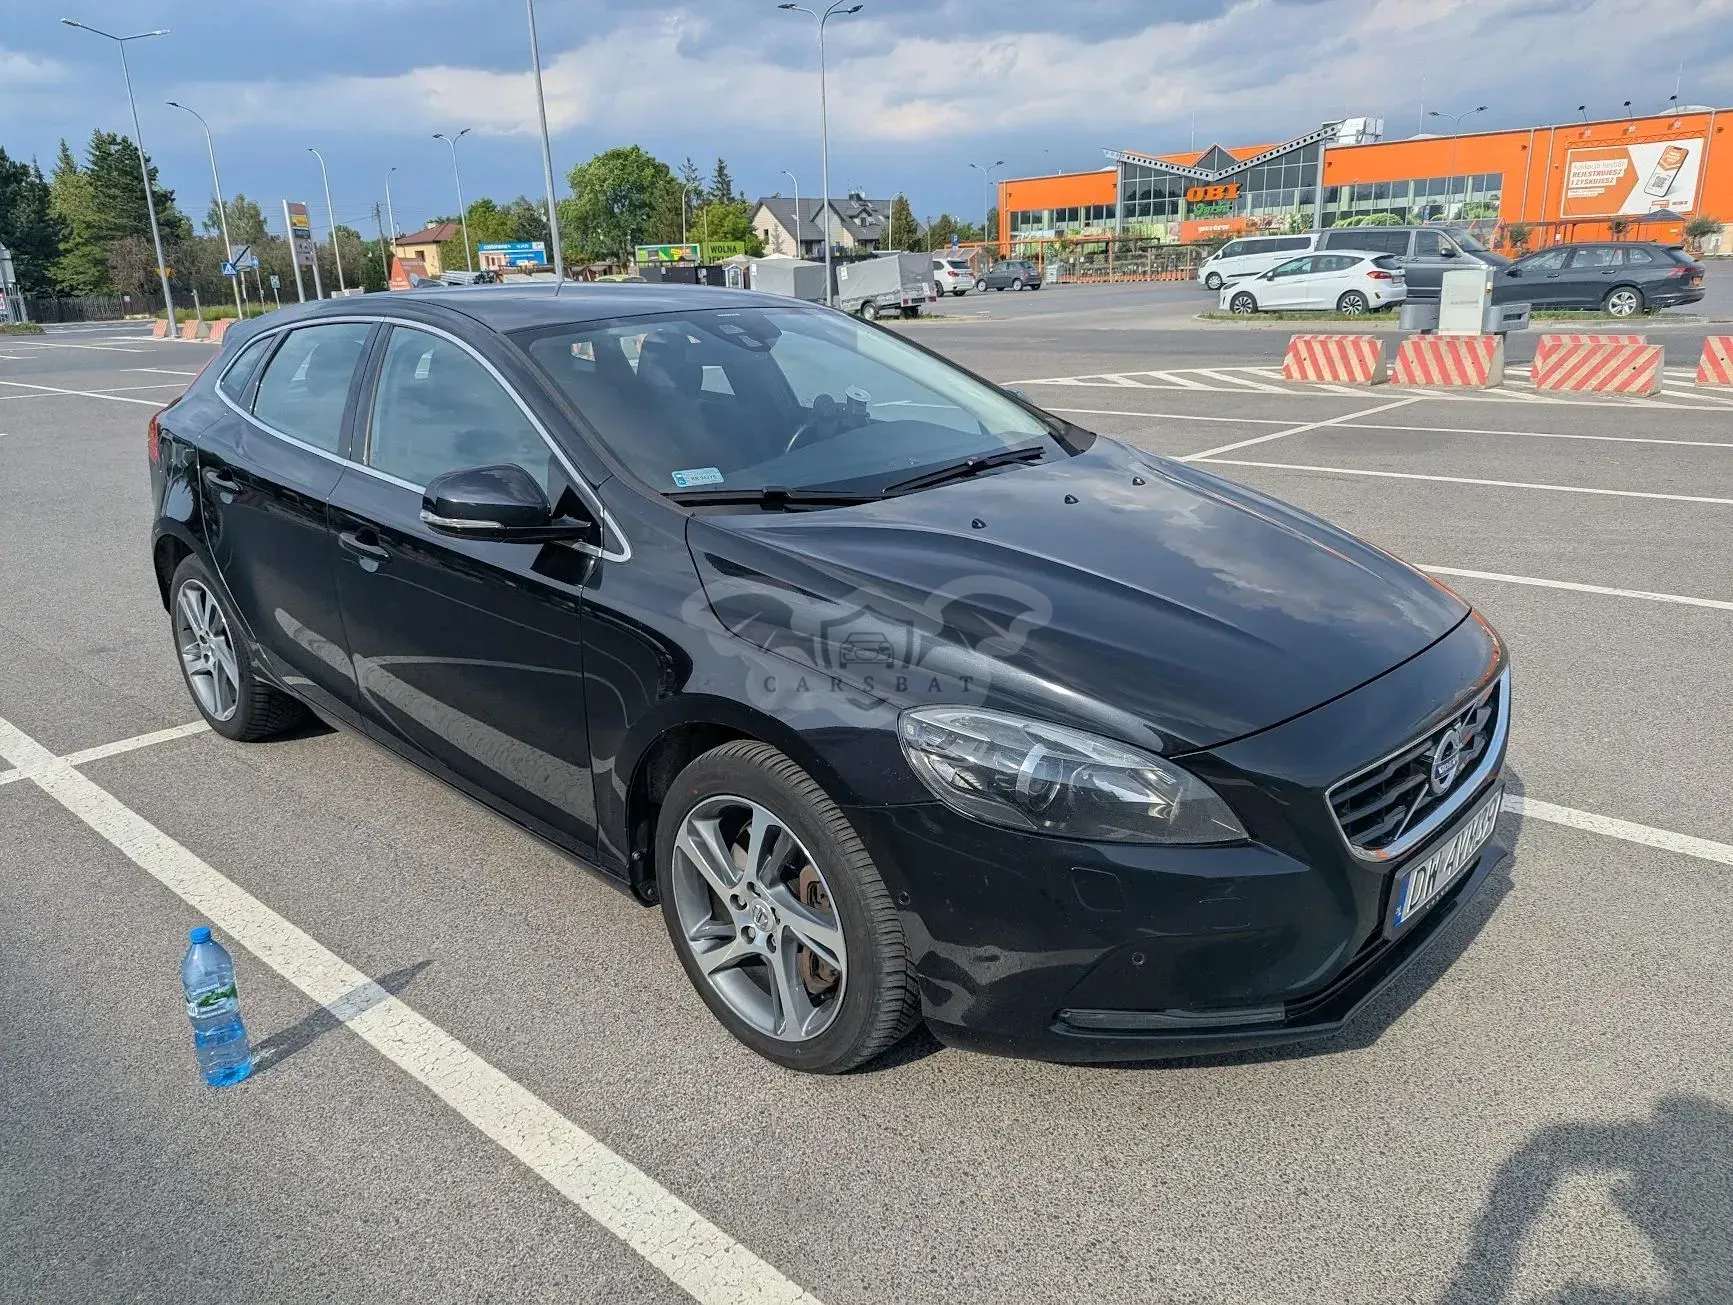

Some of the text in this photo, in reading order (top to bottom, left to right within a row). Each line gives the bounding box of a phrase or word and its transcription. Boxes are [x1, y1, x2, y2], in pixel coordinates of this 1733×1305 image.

[1572, 168, 1622, 178] REJESTRUJESZ
[1575, 177, 1614, 186] ZYSKUJESZ
[1187, 183, 1241, 202] OBI
[710, 245, 738, 254] WOLNA
[1407, 850, 1442, 913] DW
